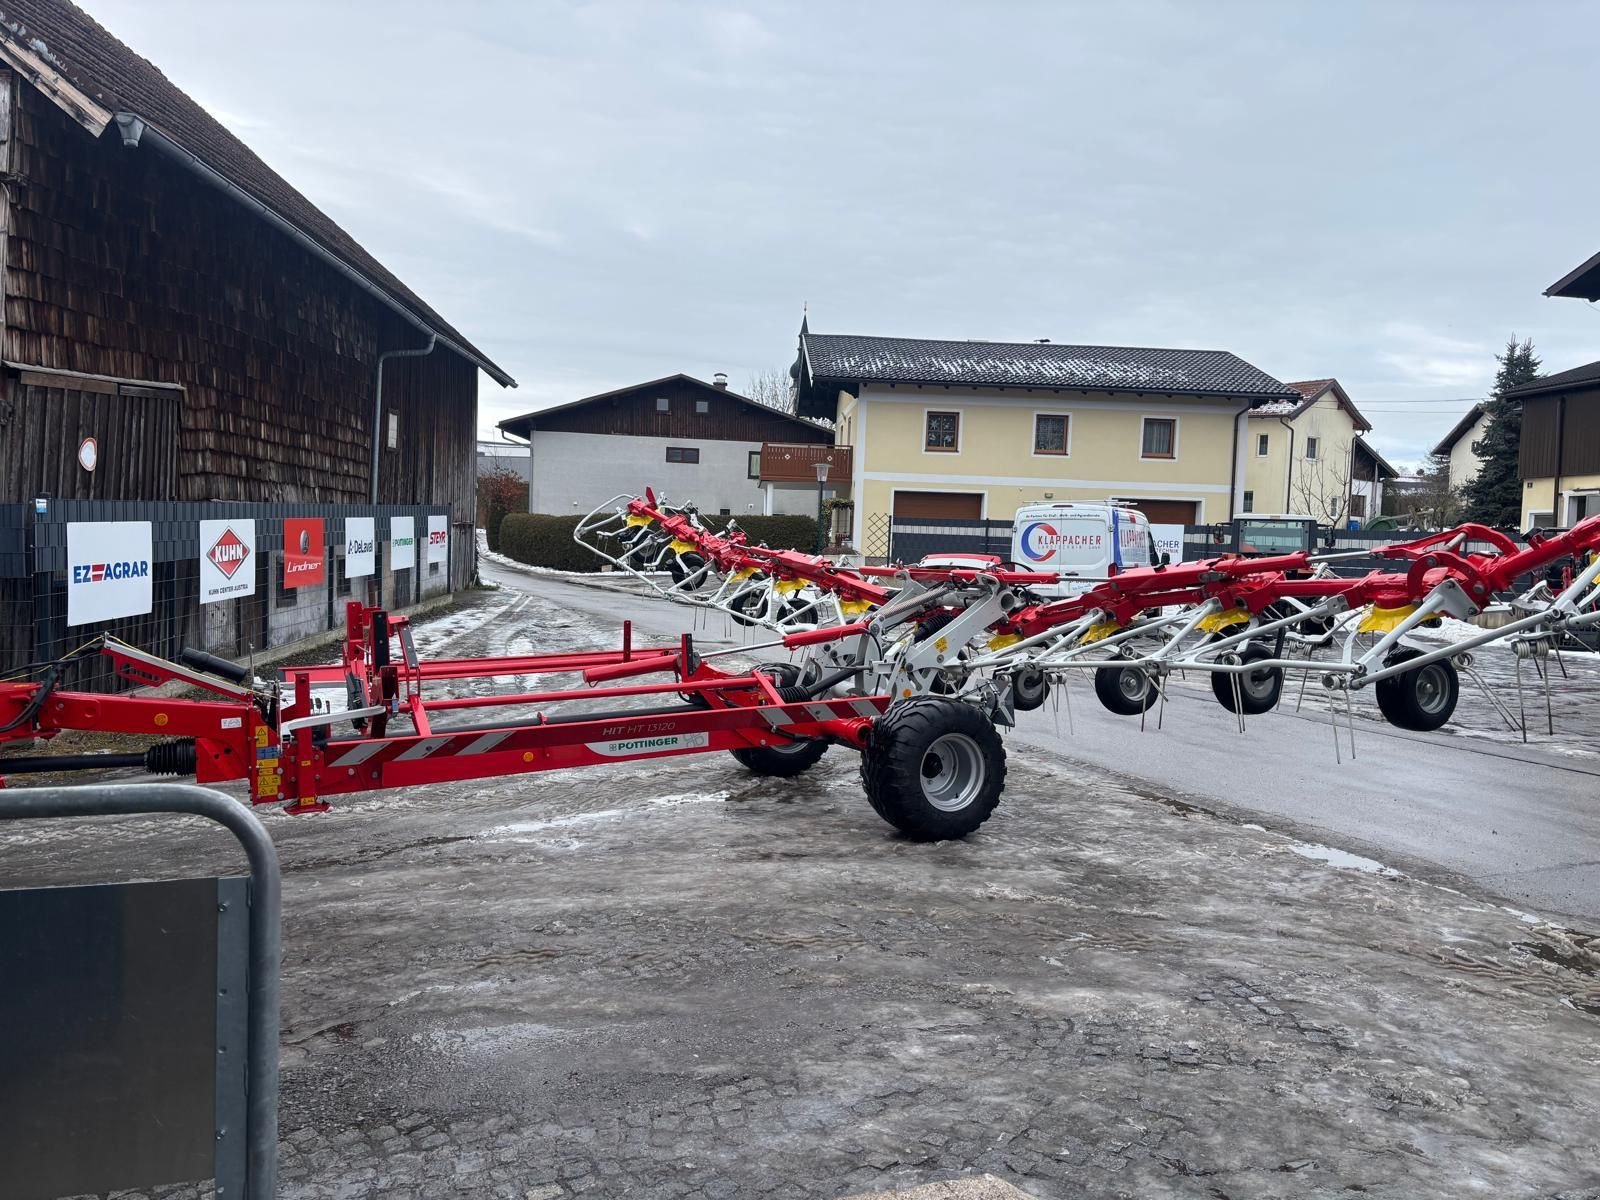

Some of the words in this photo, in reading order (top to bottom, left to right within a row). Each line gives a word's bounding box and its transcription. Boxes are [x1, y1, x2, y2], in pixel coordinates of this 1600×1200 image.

[430, 531, 446, 545] STEYR
[1038, 535, 1102, 545] KLAPPACHER
[215, 544, 243, 563] KUHN
[354, 539, 374, 554] DeLaval
[287, 561, 322, 573] Lindner
[602, 726, 625, 736] HIT
[627, 724, 645, 734] HT
[647, 722, 676, 732] 13120
